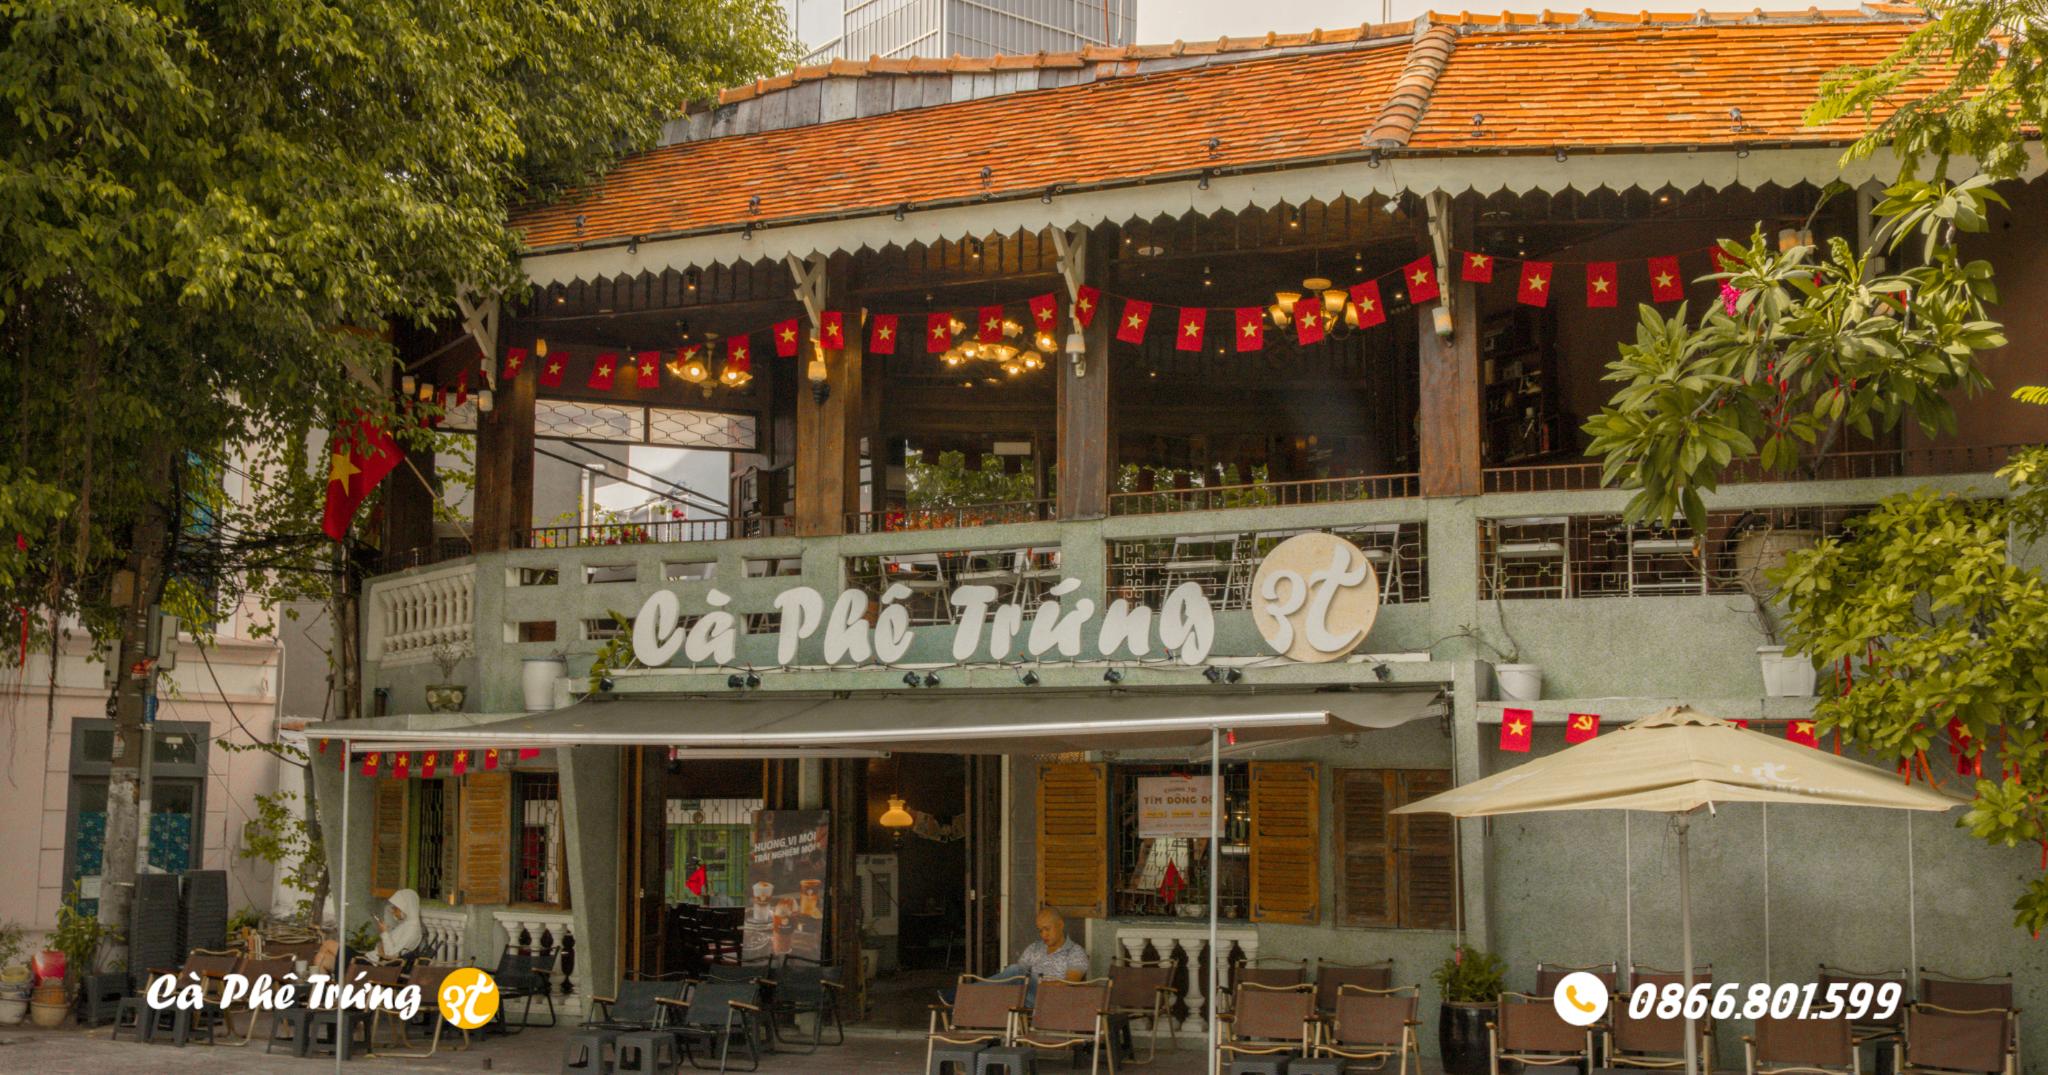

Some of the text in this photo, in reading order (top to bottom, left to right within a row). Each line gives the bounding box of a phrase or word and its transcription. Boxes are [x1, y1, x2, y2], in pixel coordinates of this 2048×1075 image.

[632, 588, 736, 667] Cà
[774, 583, 915, 665] Phê
[950, 577, 1215, 666] Trứng
